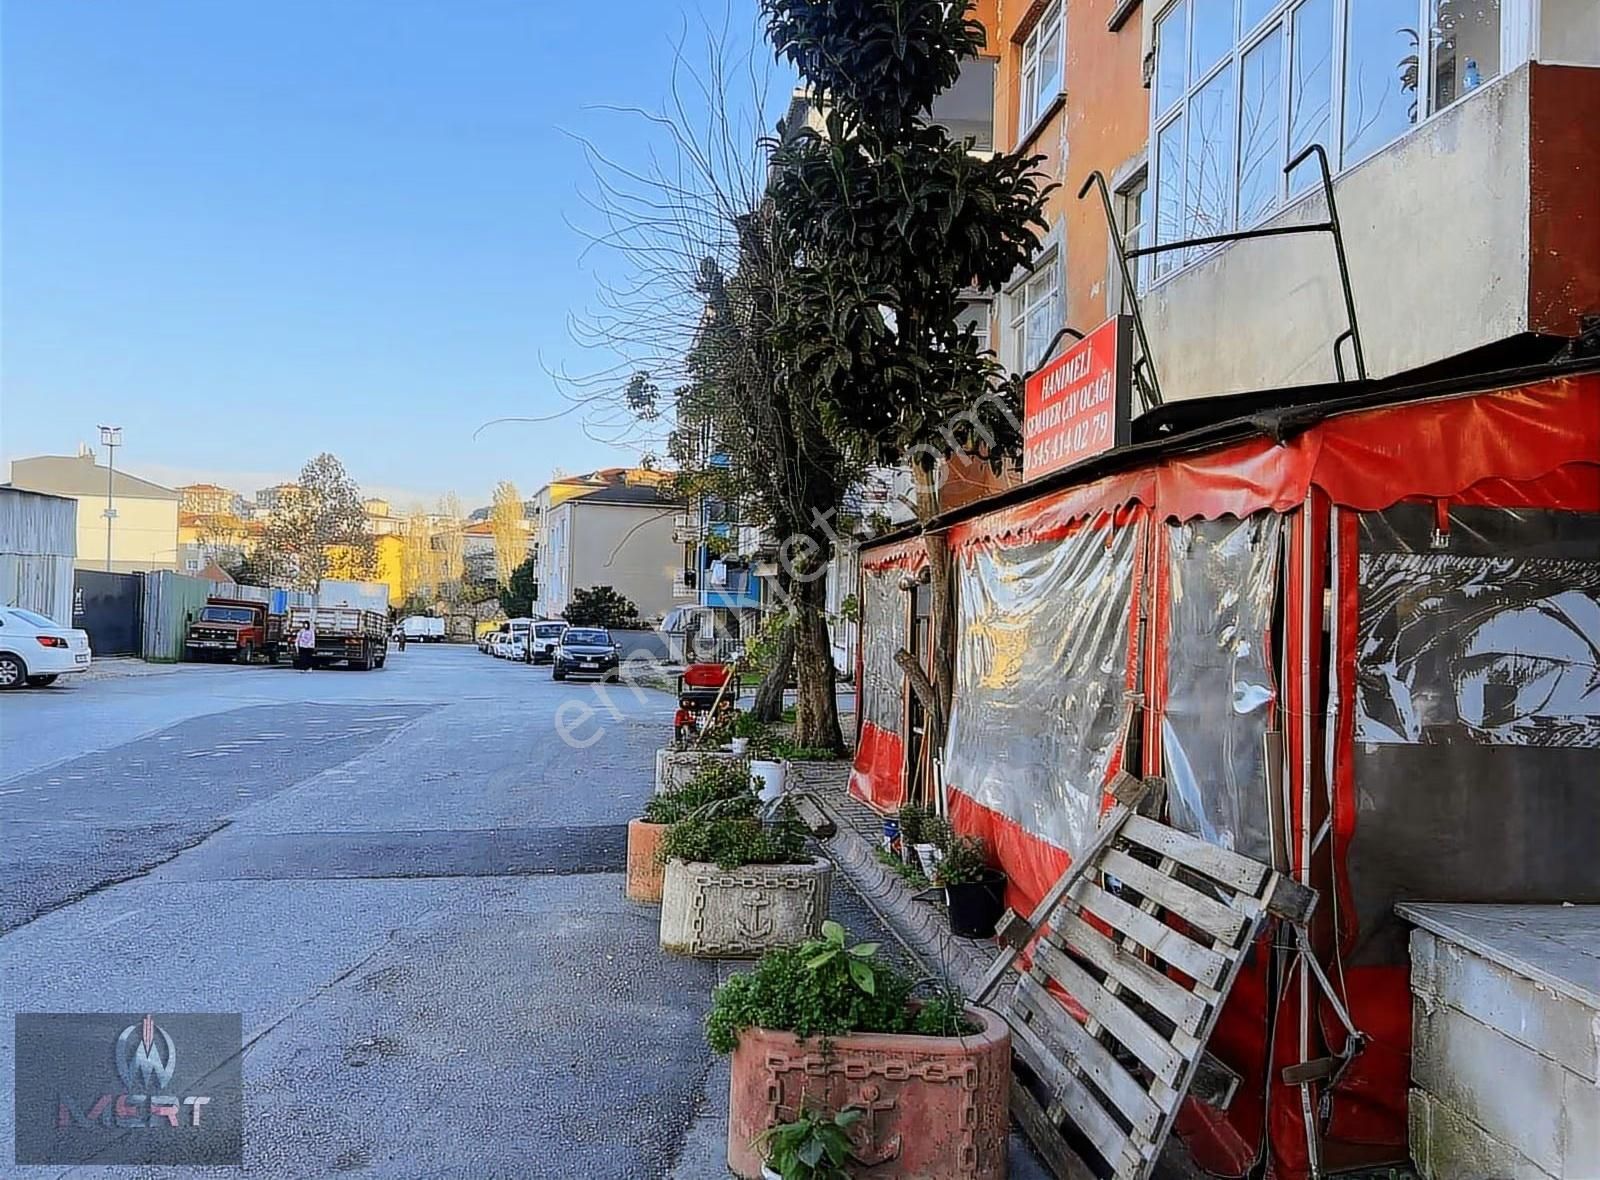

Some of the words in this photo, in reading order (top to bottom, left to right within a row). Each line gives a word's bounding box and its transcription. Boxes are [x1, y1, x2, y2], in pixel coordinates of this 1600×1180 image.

[1041, 342, 1092, 401] HANIMELİ
[1061, 393, 1079, 425] ÇAY
[1079, 370, 1111, 411] OCAĞI
[1031, 439, 1050, 467] 545
[1073, 420, 1090, 453] 02
[1092, 411, 1108, 443] 79
